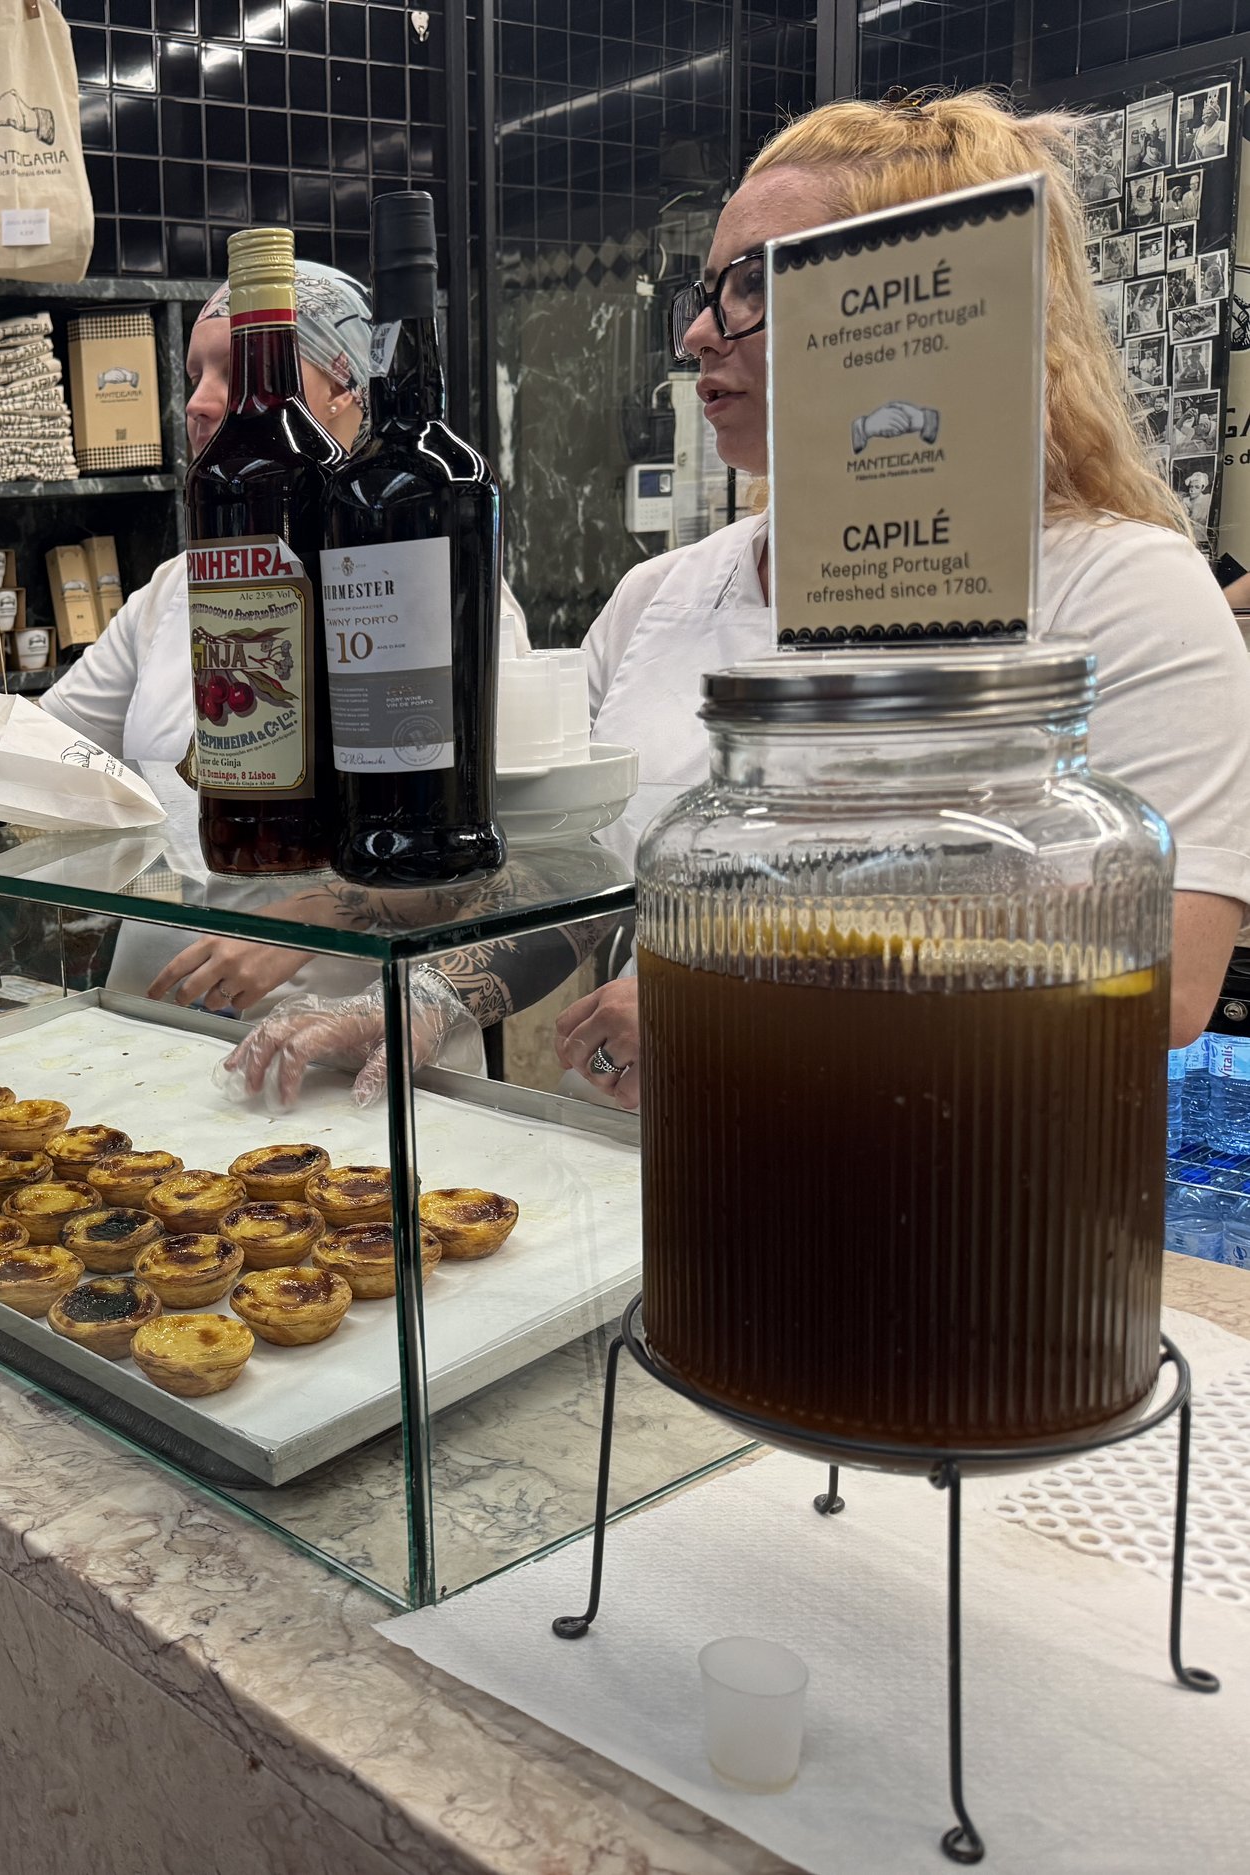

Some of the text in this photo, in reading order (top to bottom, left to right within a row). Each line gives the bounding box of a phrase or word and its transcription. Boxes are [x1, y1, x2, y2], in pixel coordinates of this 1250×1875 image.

[841, 259, 952, 316] CAPILÉ
[807, 298, 986, 350] A refrescar Portugal
[844, 334, 948, 368] desde 1780.
[847, 450, 945, 472] MANTEIGARIA
[843, 508, 950, 552] CAPILÉ
[821, 552, 970, 580] Keeping Portugal
[239, 593, 254, 601] Alc
[276, 590, 290, 598] Vol
[807, 577, 992, 603] refreshed since 1780.
[354, 615, 398, 626] PORTO
[336, 632, 374, 664] 10
[220, 758, 242, 768] Ginja
[242, 771, 247, 780] 8
[248, 771, 276, 780] Lisboa
[1218, 1046, 1232, 1076] Vitalis
